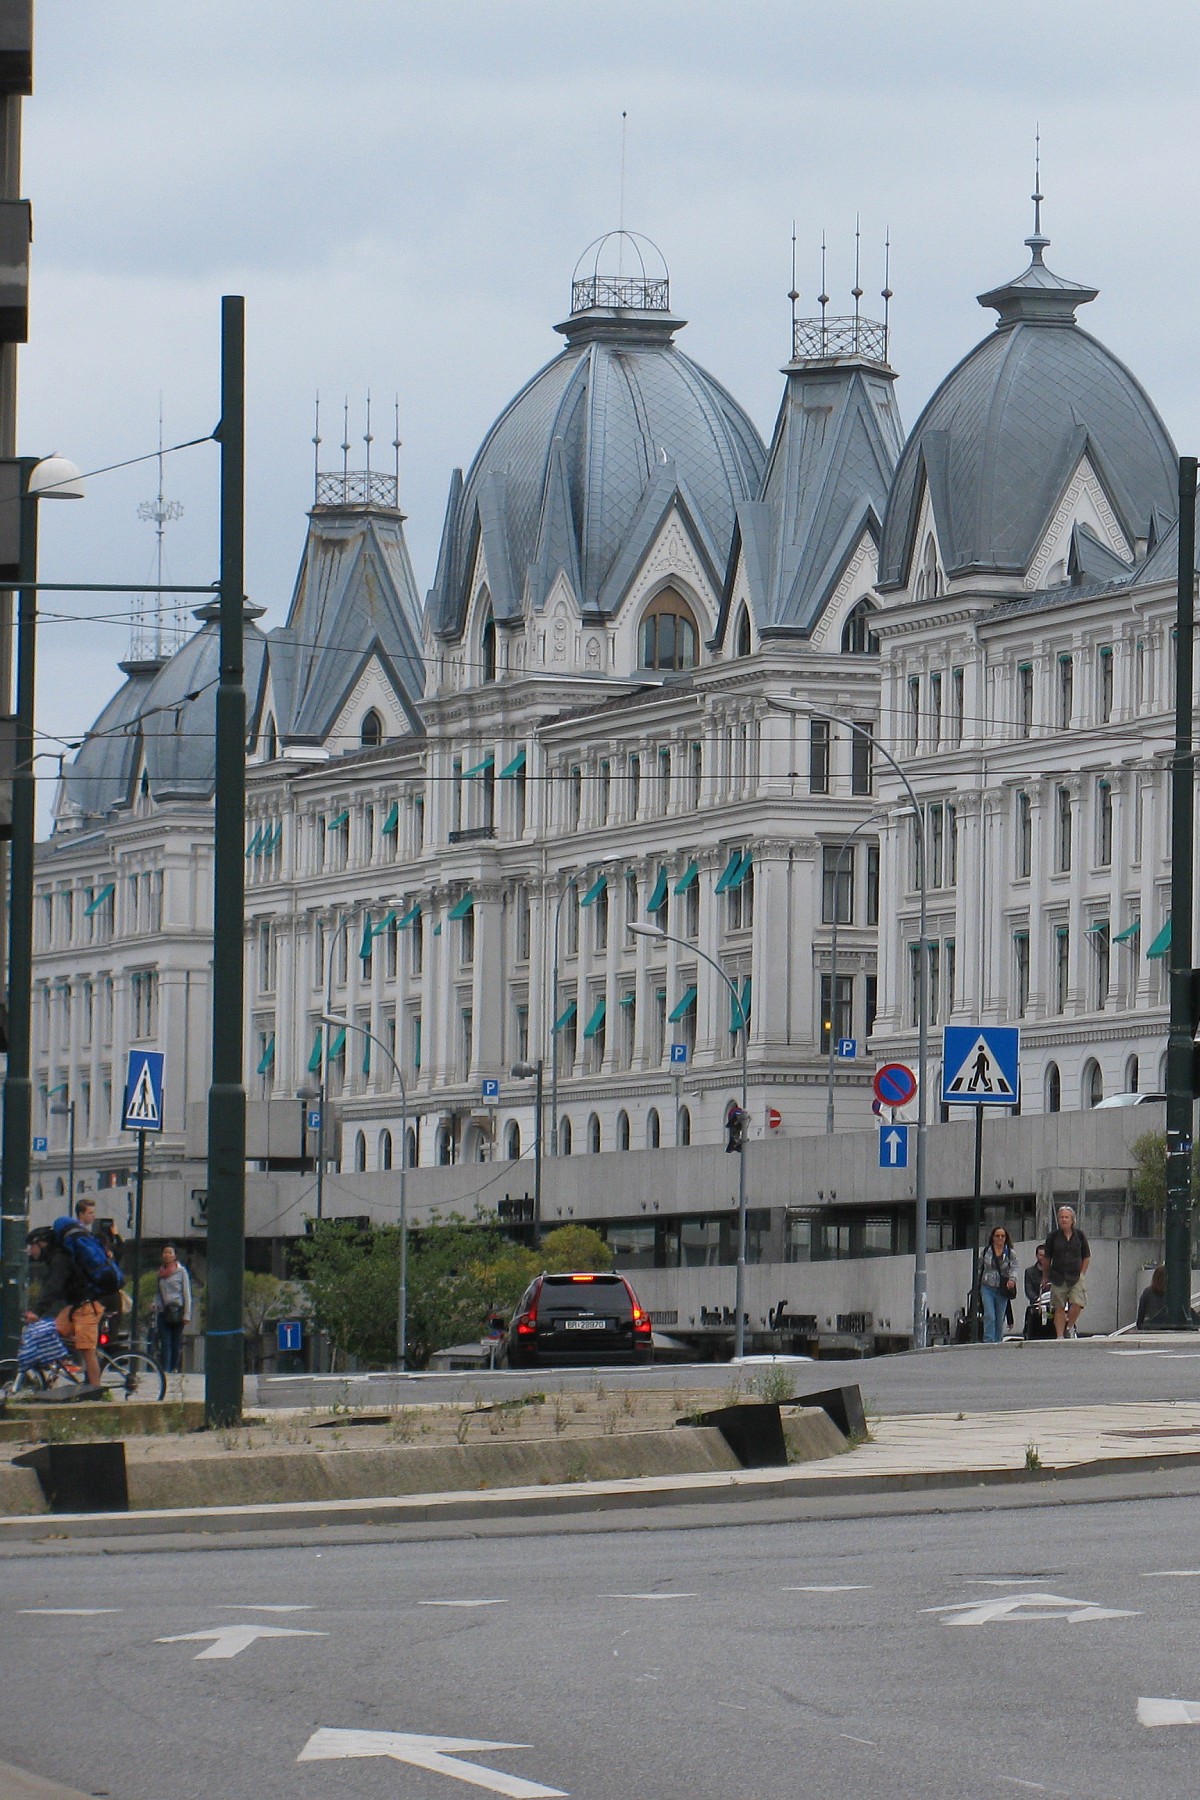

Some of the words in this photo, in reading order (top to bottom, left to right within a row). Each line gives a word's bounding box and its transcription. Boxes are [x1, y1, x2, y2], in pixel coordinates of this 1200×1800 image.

[674, 1046, 684, 1060] P
[843, 1041, 853, 1056] P
[486, 1081, 496, 1095] P
